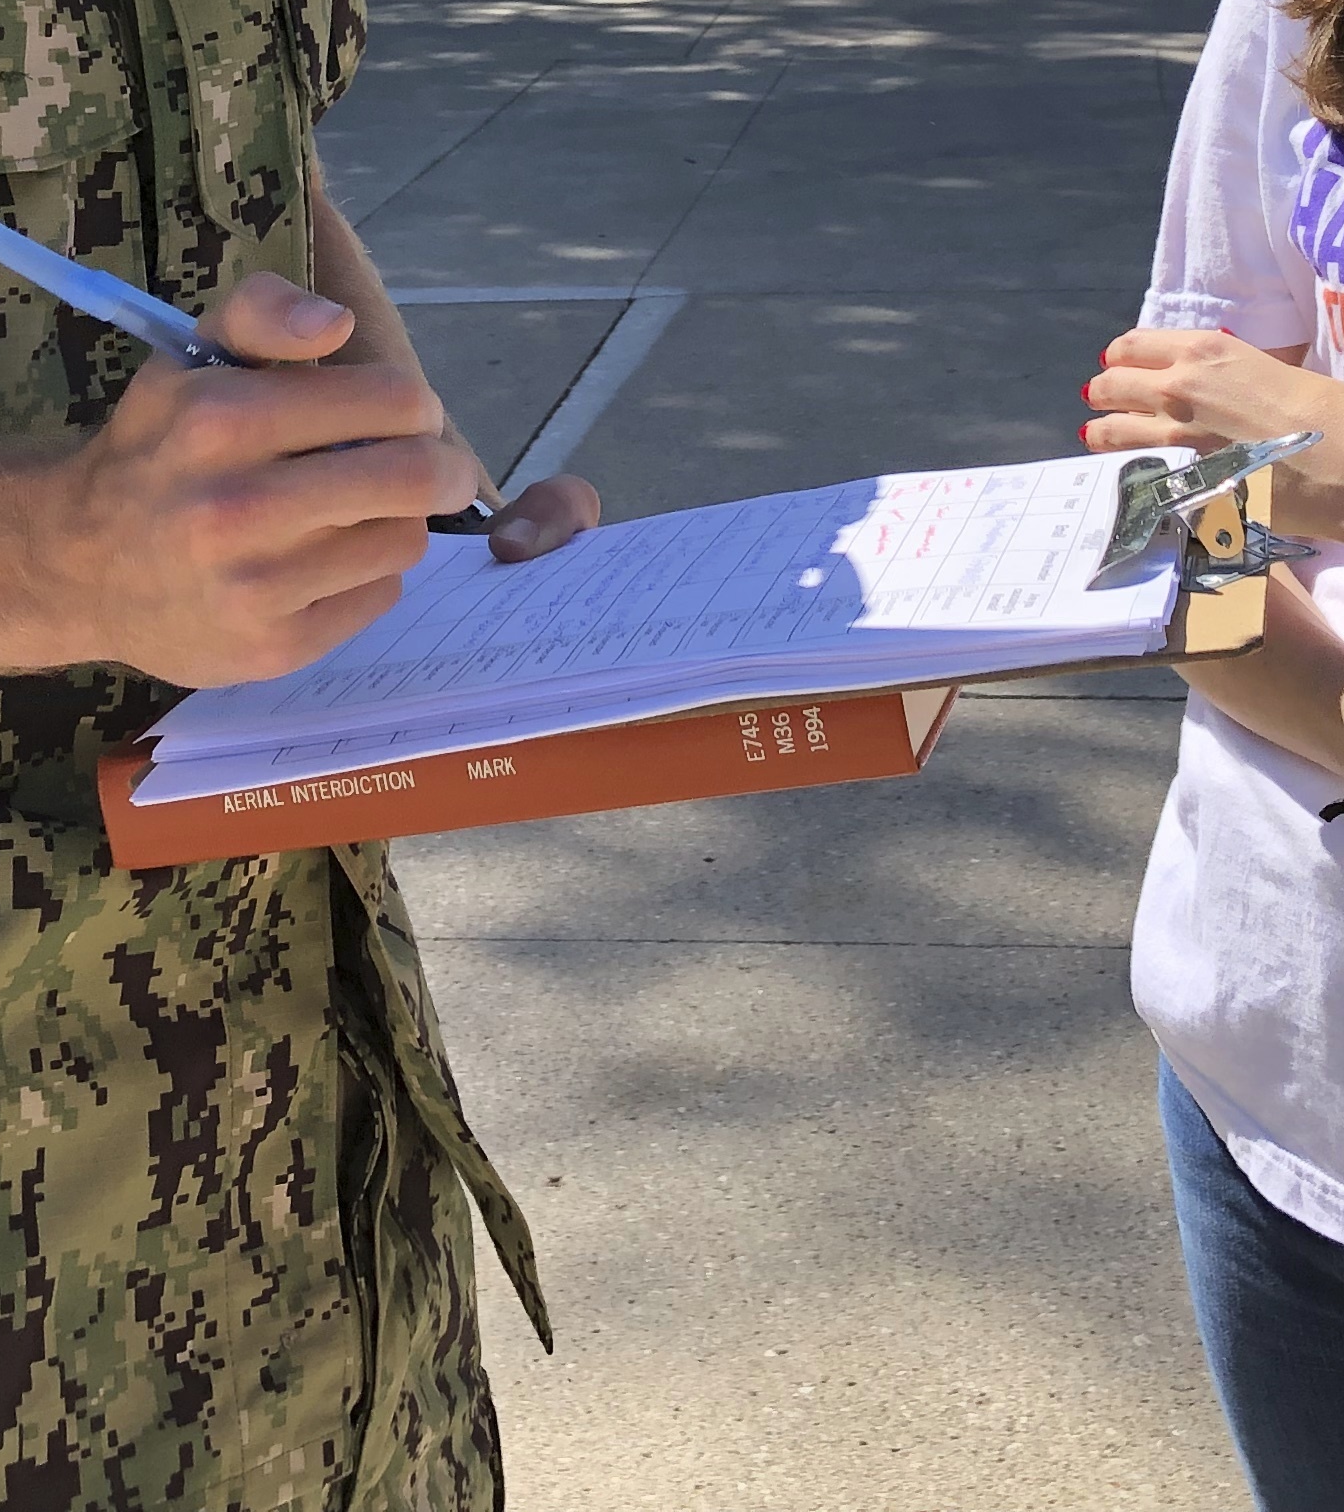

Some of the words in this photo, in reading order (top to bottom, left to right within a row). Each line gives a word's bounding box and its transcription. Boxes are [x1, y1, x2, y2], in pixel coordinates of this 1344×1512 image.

[738, 712, 766, 763] E745
[773, 712, 797, 755] M36
[802, 705, 830, 752] 1994
[223, 792, 285, 814] AERIAL
[290, 770, 416, 804] INTERDICTION
[467, 756, 517, 781] MARK
